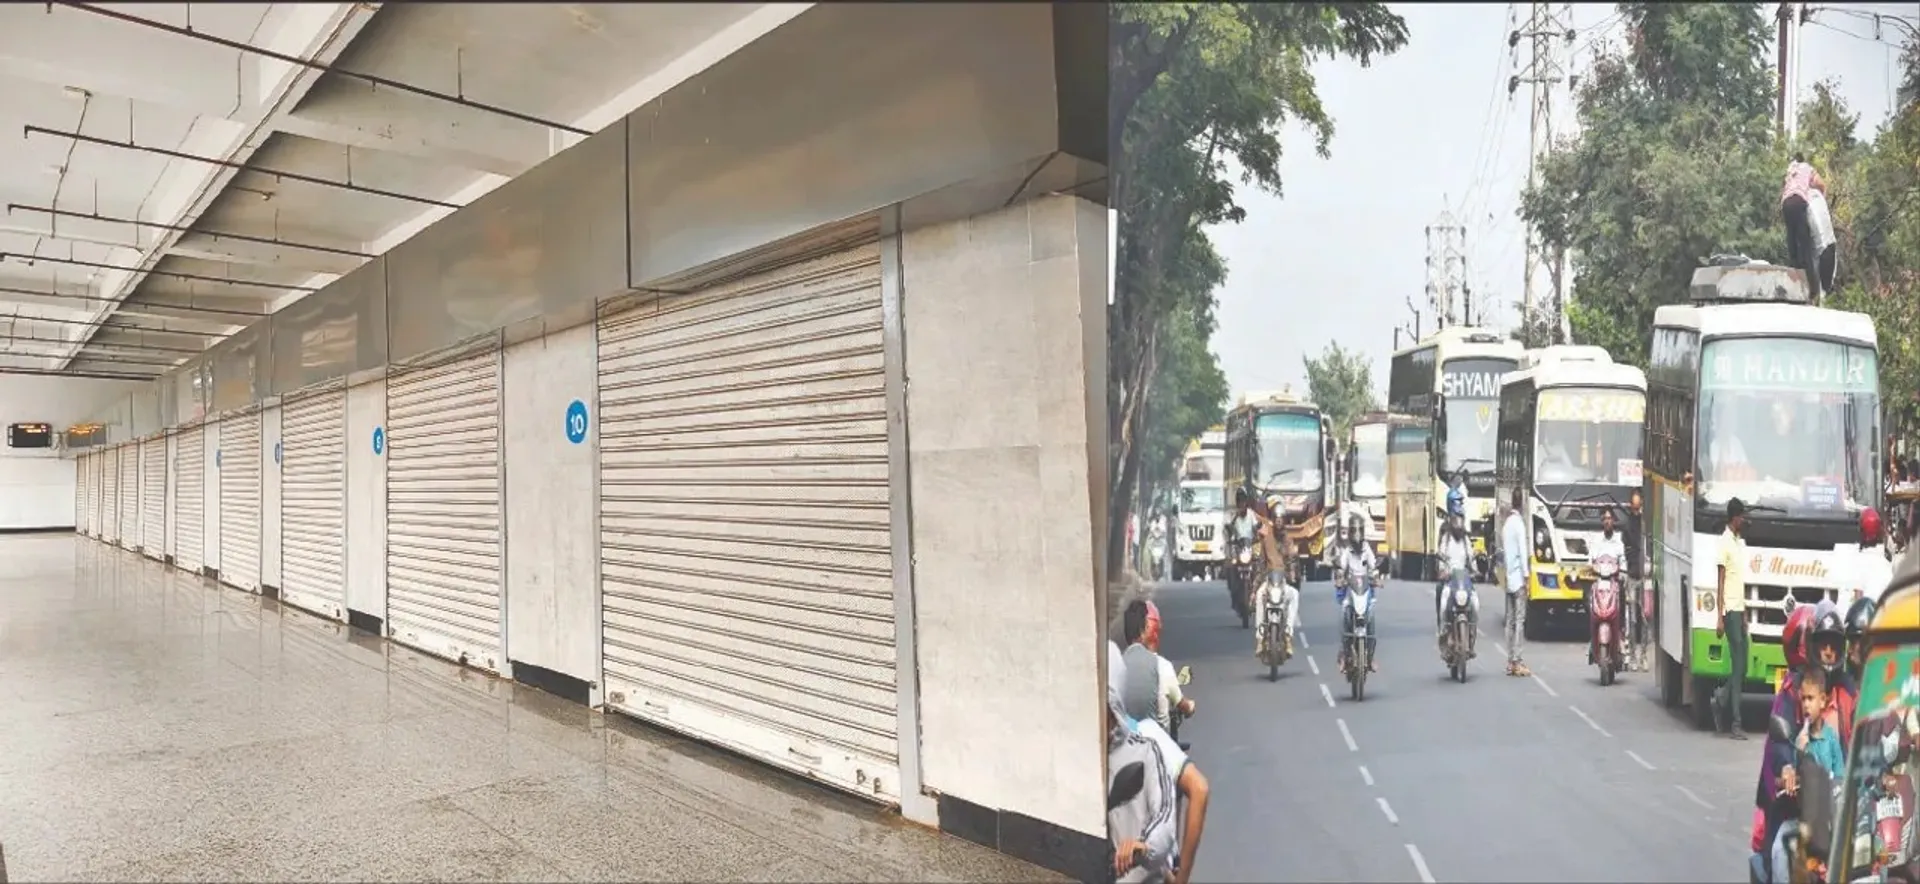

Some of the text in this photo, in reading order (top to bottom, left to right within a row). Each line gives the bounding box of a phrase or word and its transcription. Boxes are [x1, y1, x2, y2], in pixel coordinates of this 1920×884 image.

[1744, 354, 1866, 384] MANDIR
[570, 413, 585, 436] 10
[1769, 554, 1828, 577] Mandir
